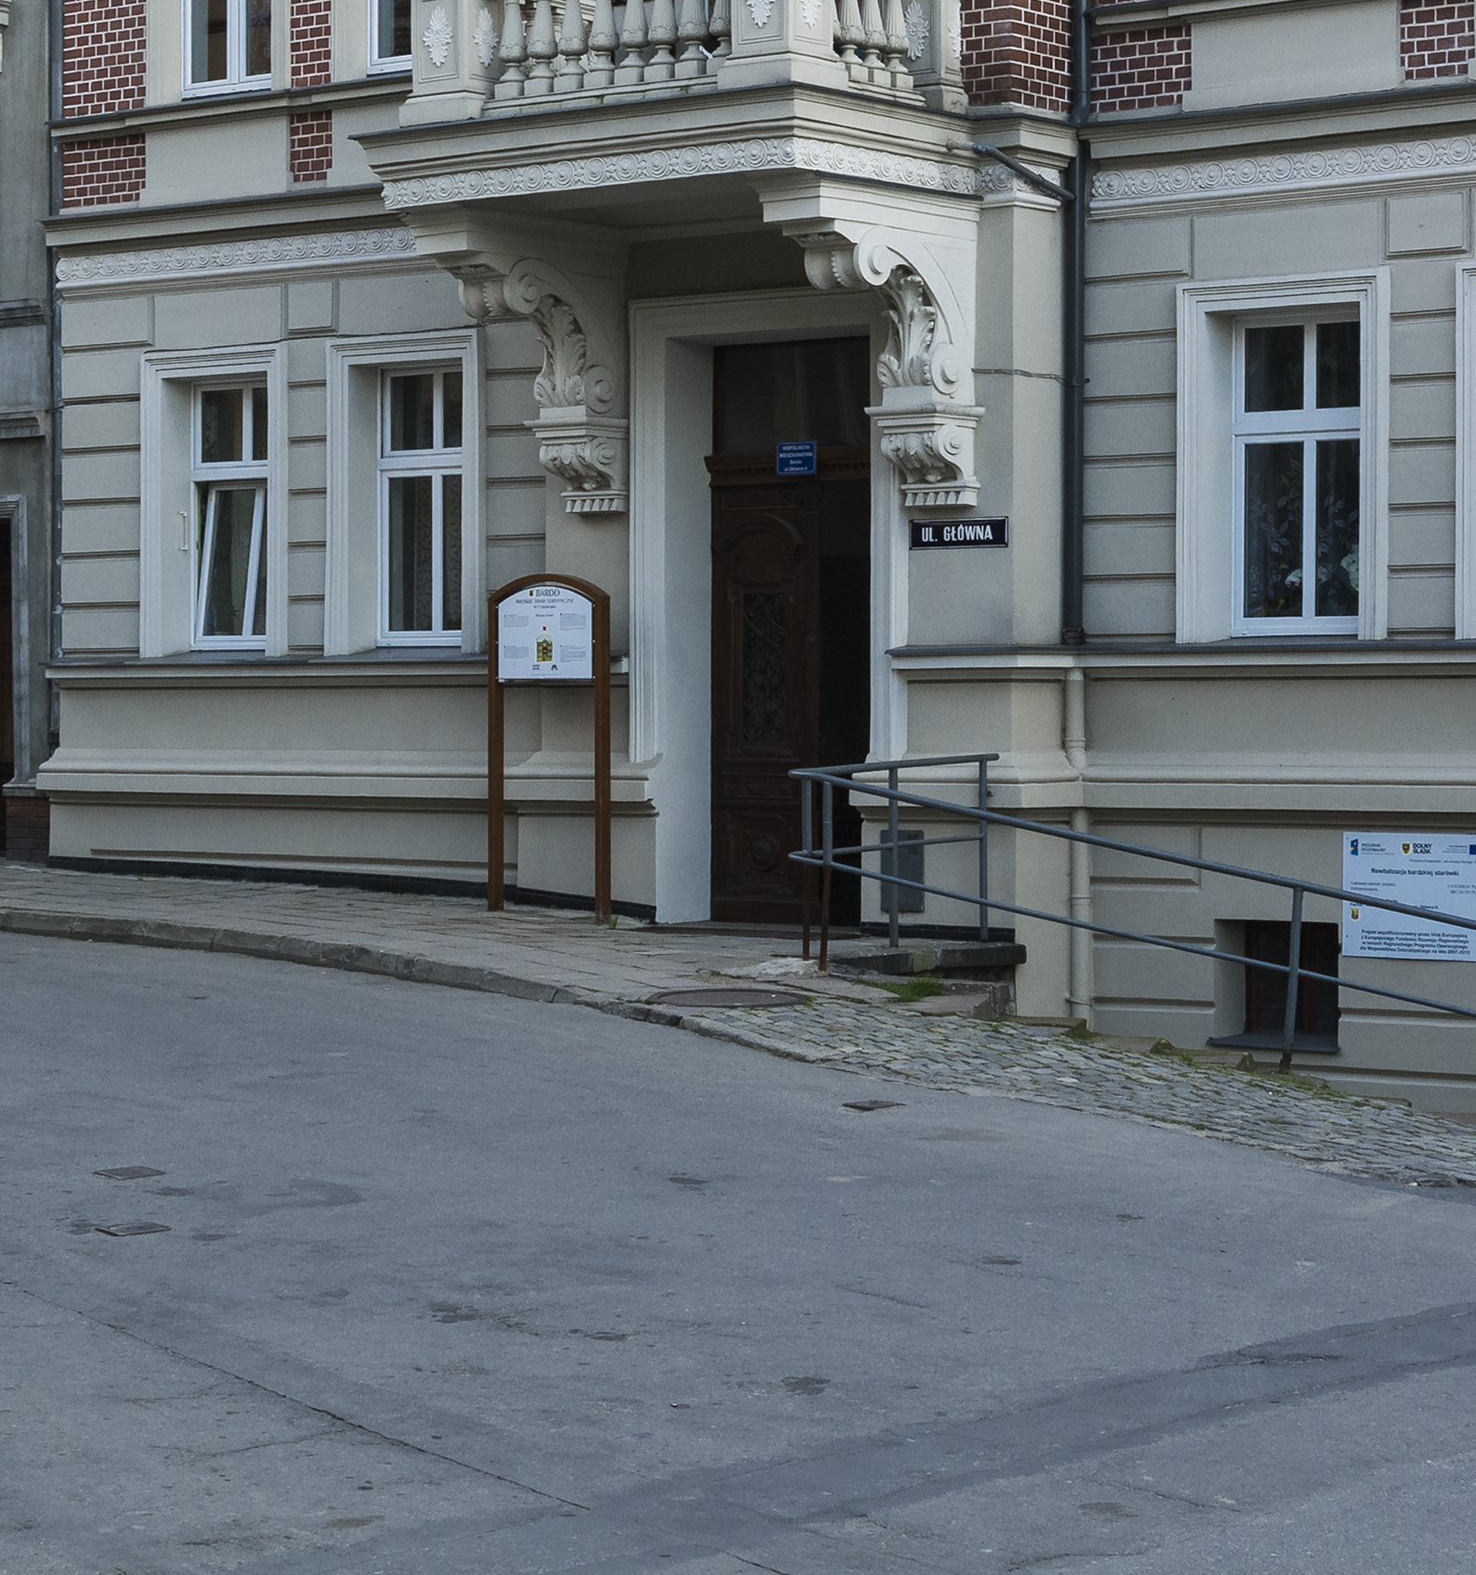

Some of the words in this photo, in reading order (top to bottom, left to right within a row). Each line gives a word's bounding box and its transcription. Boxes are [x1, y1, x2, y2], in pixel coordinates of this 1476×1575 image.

[921, 527, 938, 542] UL.
[943, 524, 993, 542] GŁÓWNA
[535, 589, 561, 597] BARDO
